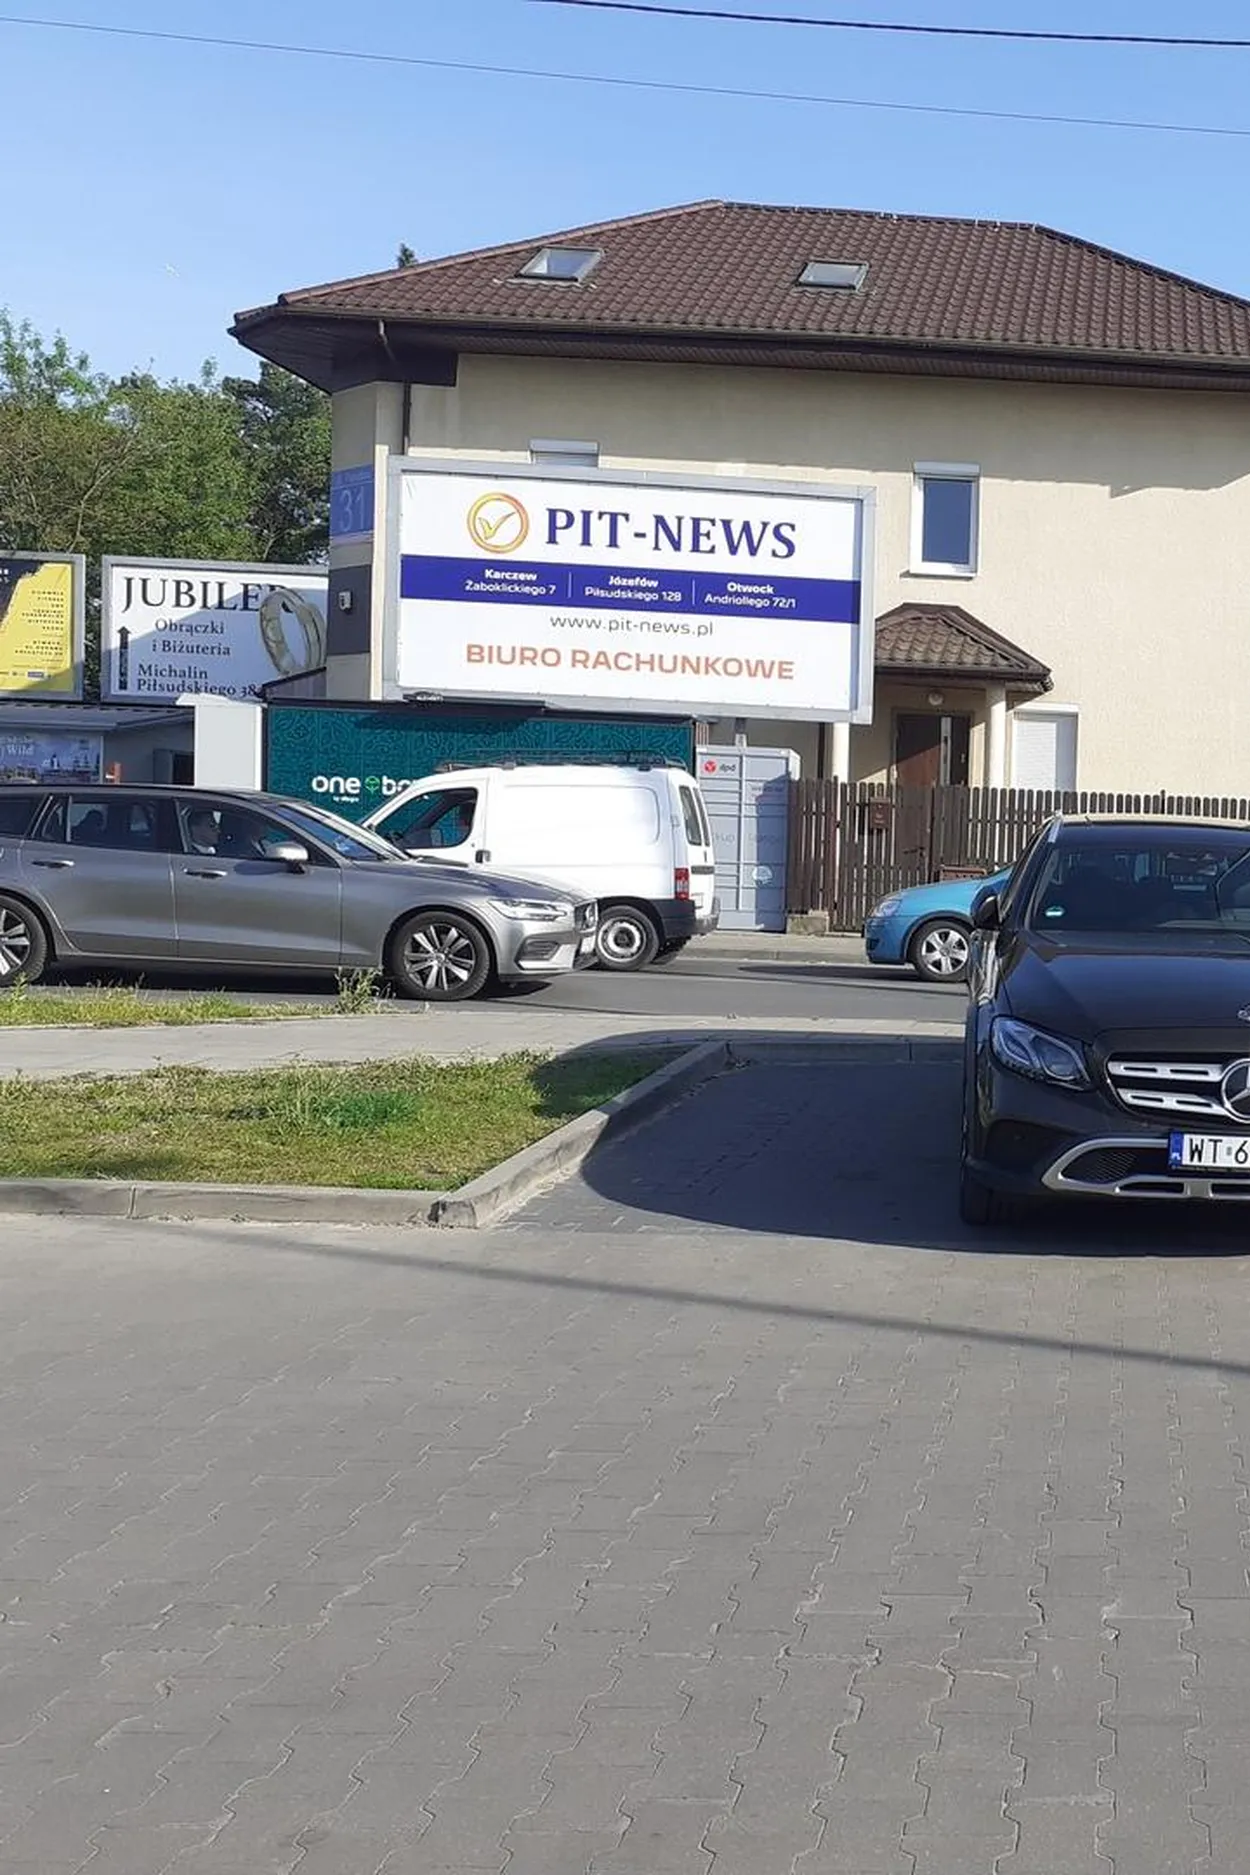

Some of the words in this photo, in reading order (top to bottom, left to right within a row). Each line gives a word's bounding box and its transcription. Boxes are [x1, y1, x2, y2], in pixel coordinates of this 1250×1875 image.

[340, 486, 365, 532] 31
[546, 507, 796, 559] PIT-NEWS
[485, 568, 537, 581] Karczew
[609, 575, 659, 588] Józefów
[549, 584, 557, 594] 7
[585, 586, 659, 601] Piłsudskiego
[662, 591, 682, 602] 128
[727, 581, 774, 594] Otwock
[772, 597, 796, 609] 72/1
[155, 617, 225, 636] Obrączki
[550, 615, 714, 637] www.pit-news.pl
[152, 640, 157, 652] i
[162, 640, 231, 656] Biżuteria
[466, 643, 561, 666] BIURO
[571, 649, 795, 680] RACHUNKOWE
[138, 664, 208, 679] Michalin
[312, 775, 361, 794] one
[1189, 1138, 1223, 1164] WT
